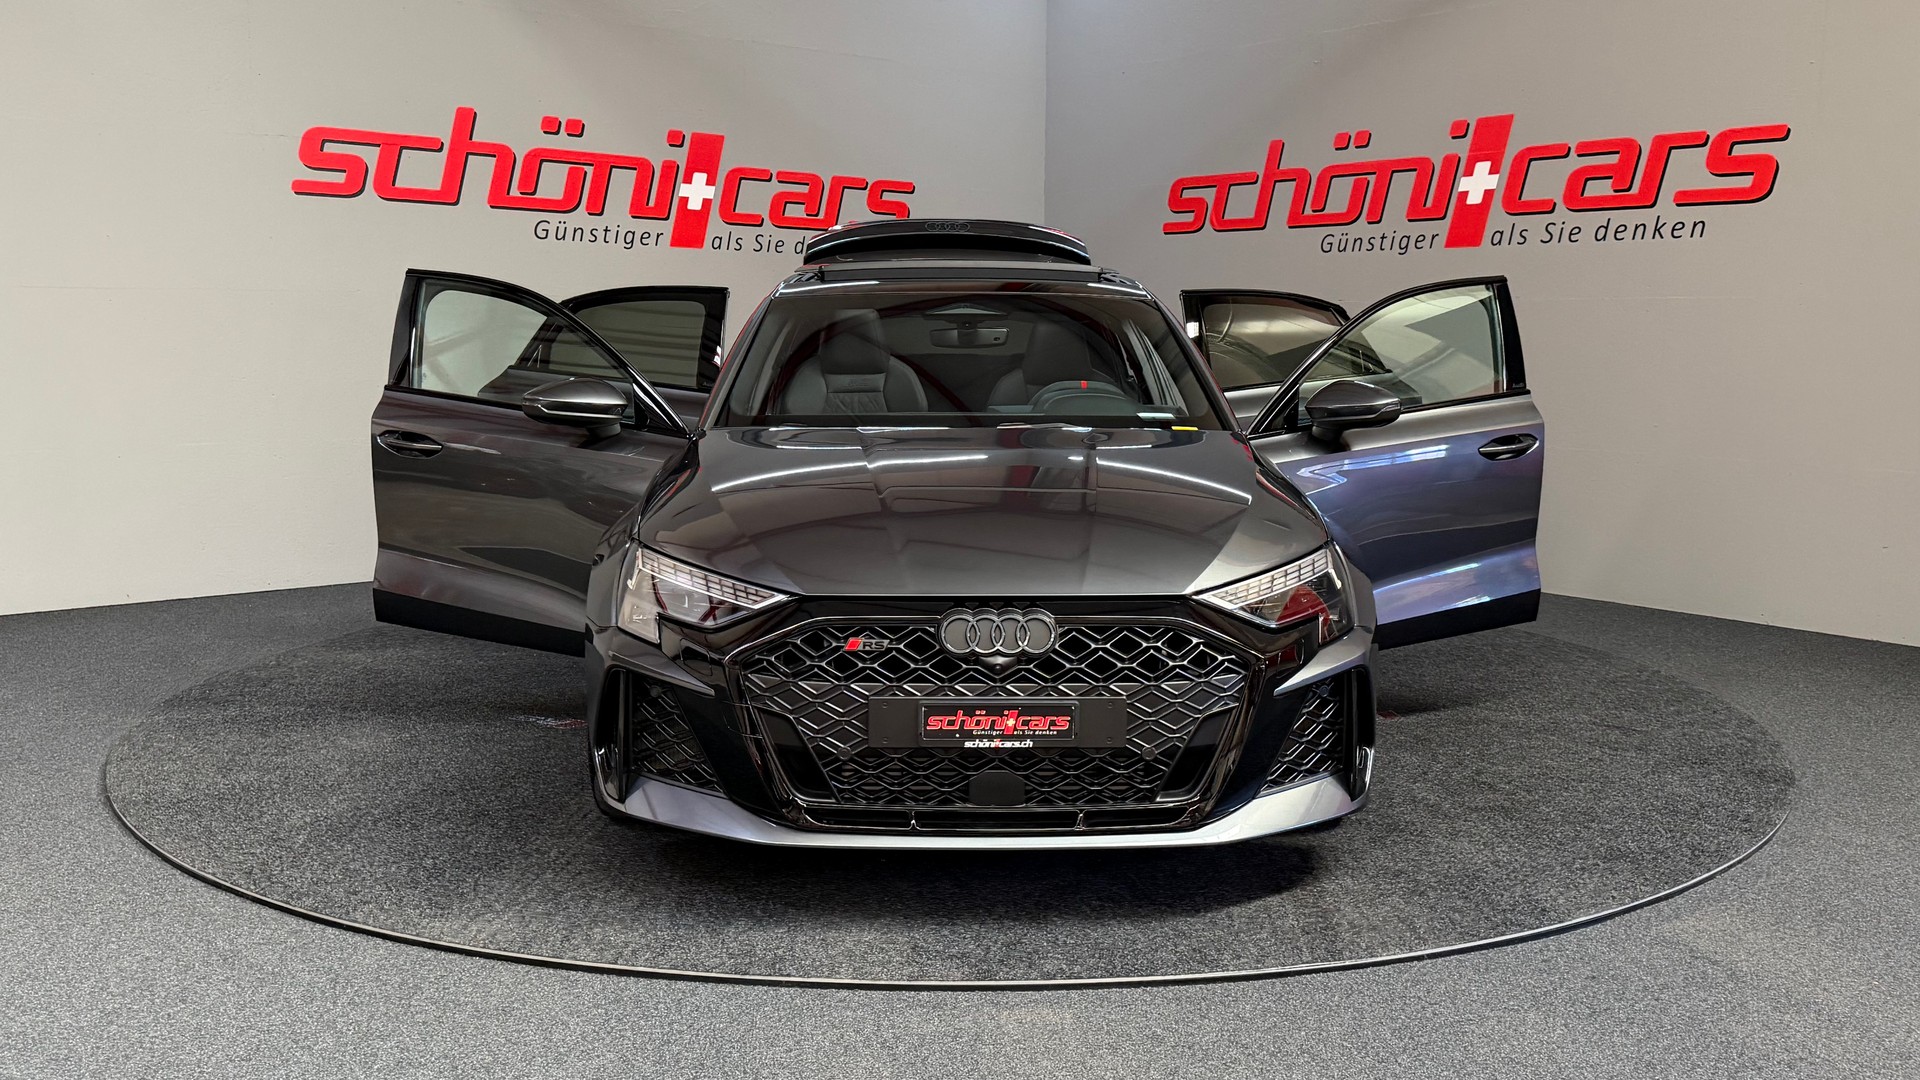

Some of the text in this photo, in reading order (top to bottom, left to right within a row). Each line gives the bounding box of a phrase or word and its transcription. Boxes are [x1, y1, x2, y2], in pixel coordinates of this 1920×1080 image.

[533, 219, 664, 250] Günstiger
[711, 231, 743, 252] als
[753, 233, 785, 254] Sie
[1320, 214, 1707, 256] Günstiger als Sie denken
[862, 641, 885, 650] RS
